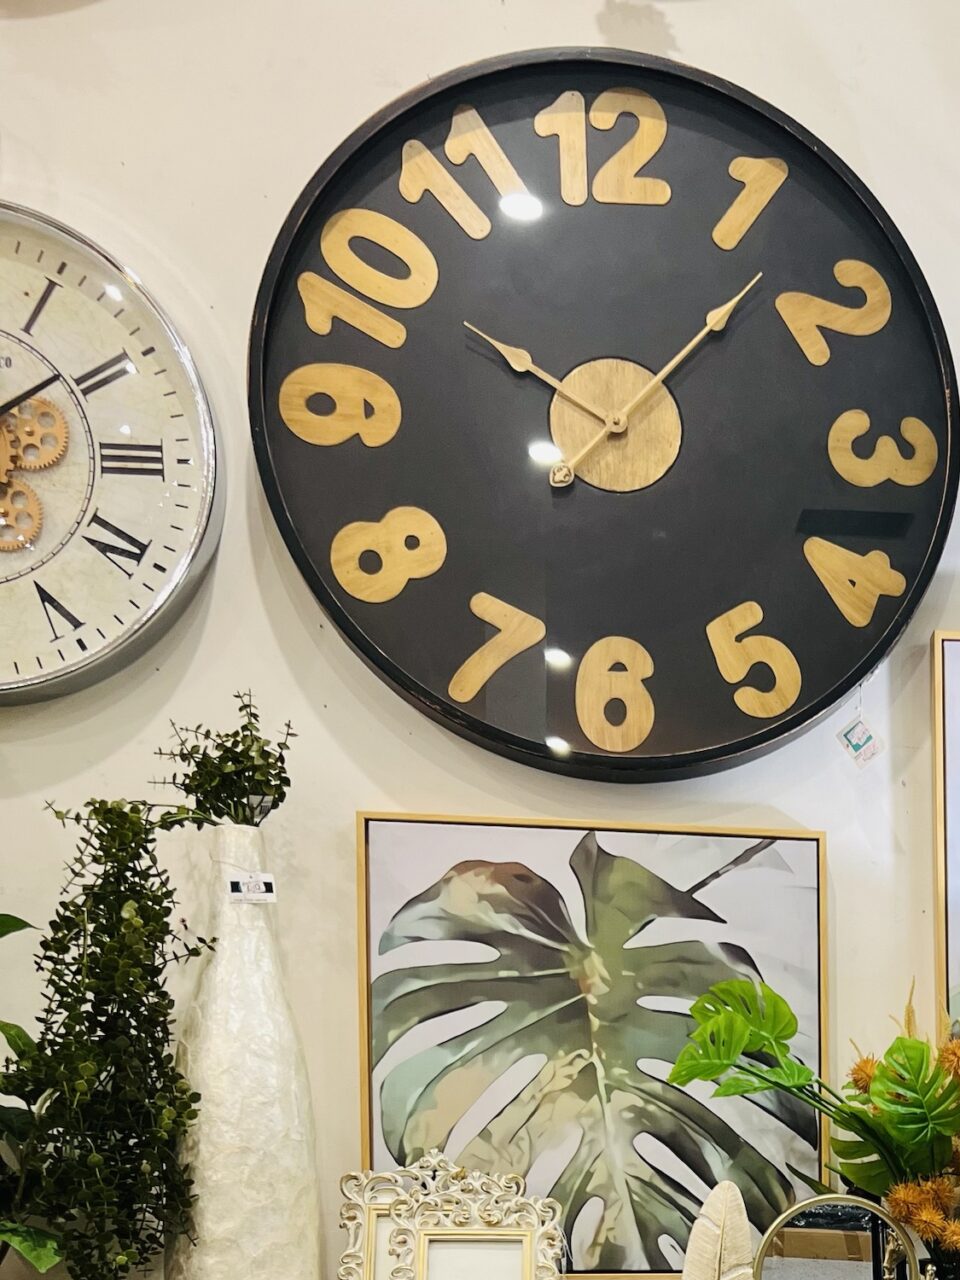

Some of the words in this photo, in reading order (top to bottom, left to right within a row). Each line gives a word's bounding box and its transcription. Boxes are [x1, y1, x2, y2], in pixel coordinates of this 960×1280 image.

[399, 104, 541, 240] 11
[535, 87, 671, 206] 12
[711, 156, 789, 251] 1
[297, 208, 439, 349] 10
[775, 259, 892, 366] 2
[279, 363, 402, 448] 9
[828, 409, 938, 488] 3
[330, 506, 448, 603] 8
[804, 536, 907, 628] 4
[448, 592, 546, 703] 7
[576, 636, 655, 752] 6
[706, 601, 802, 717] 5
